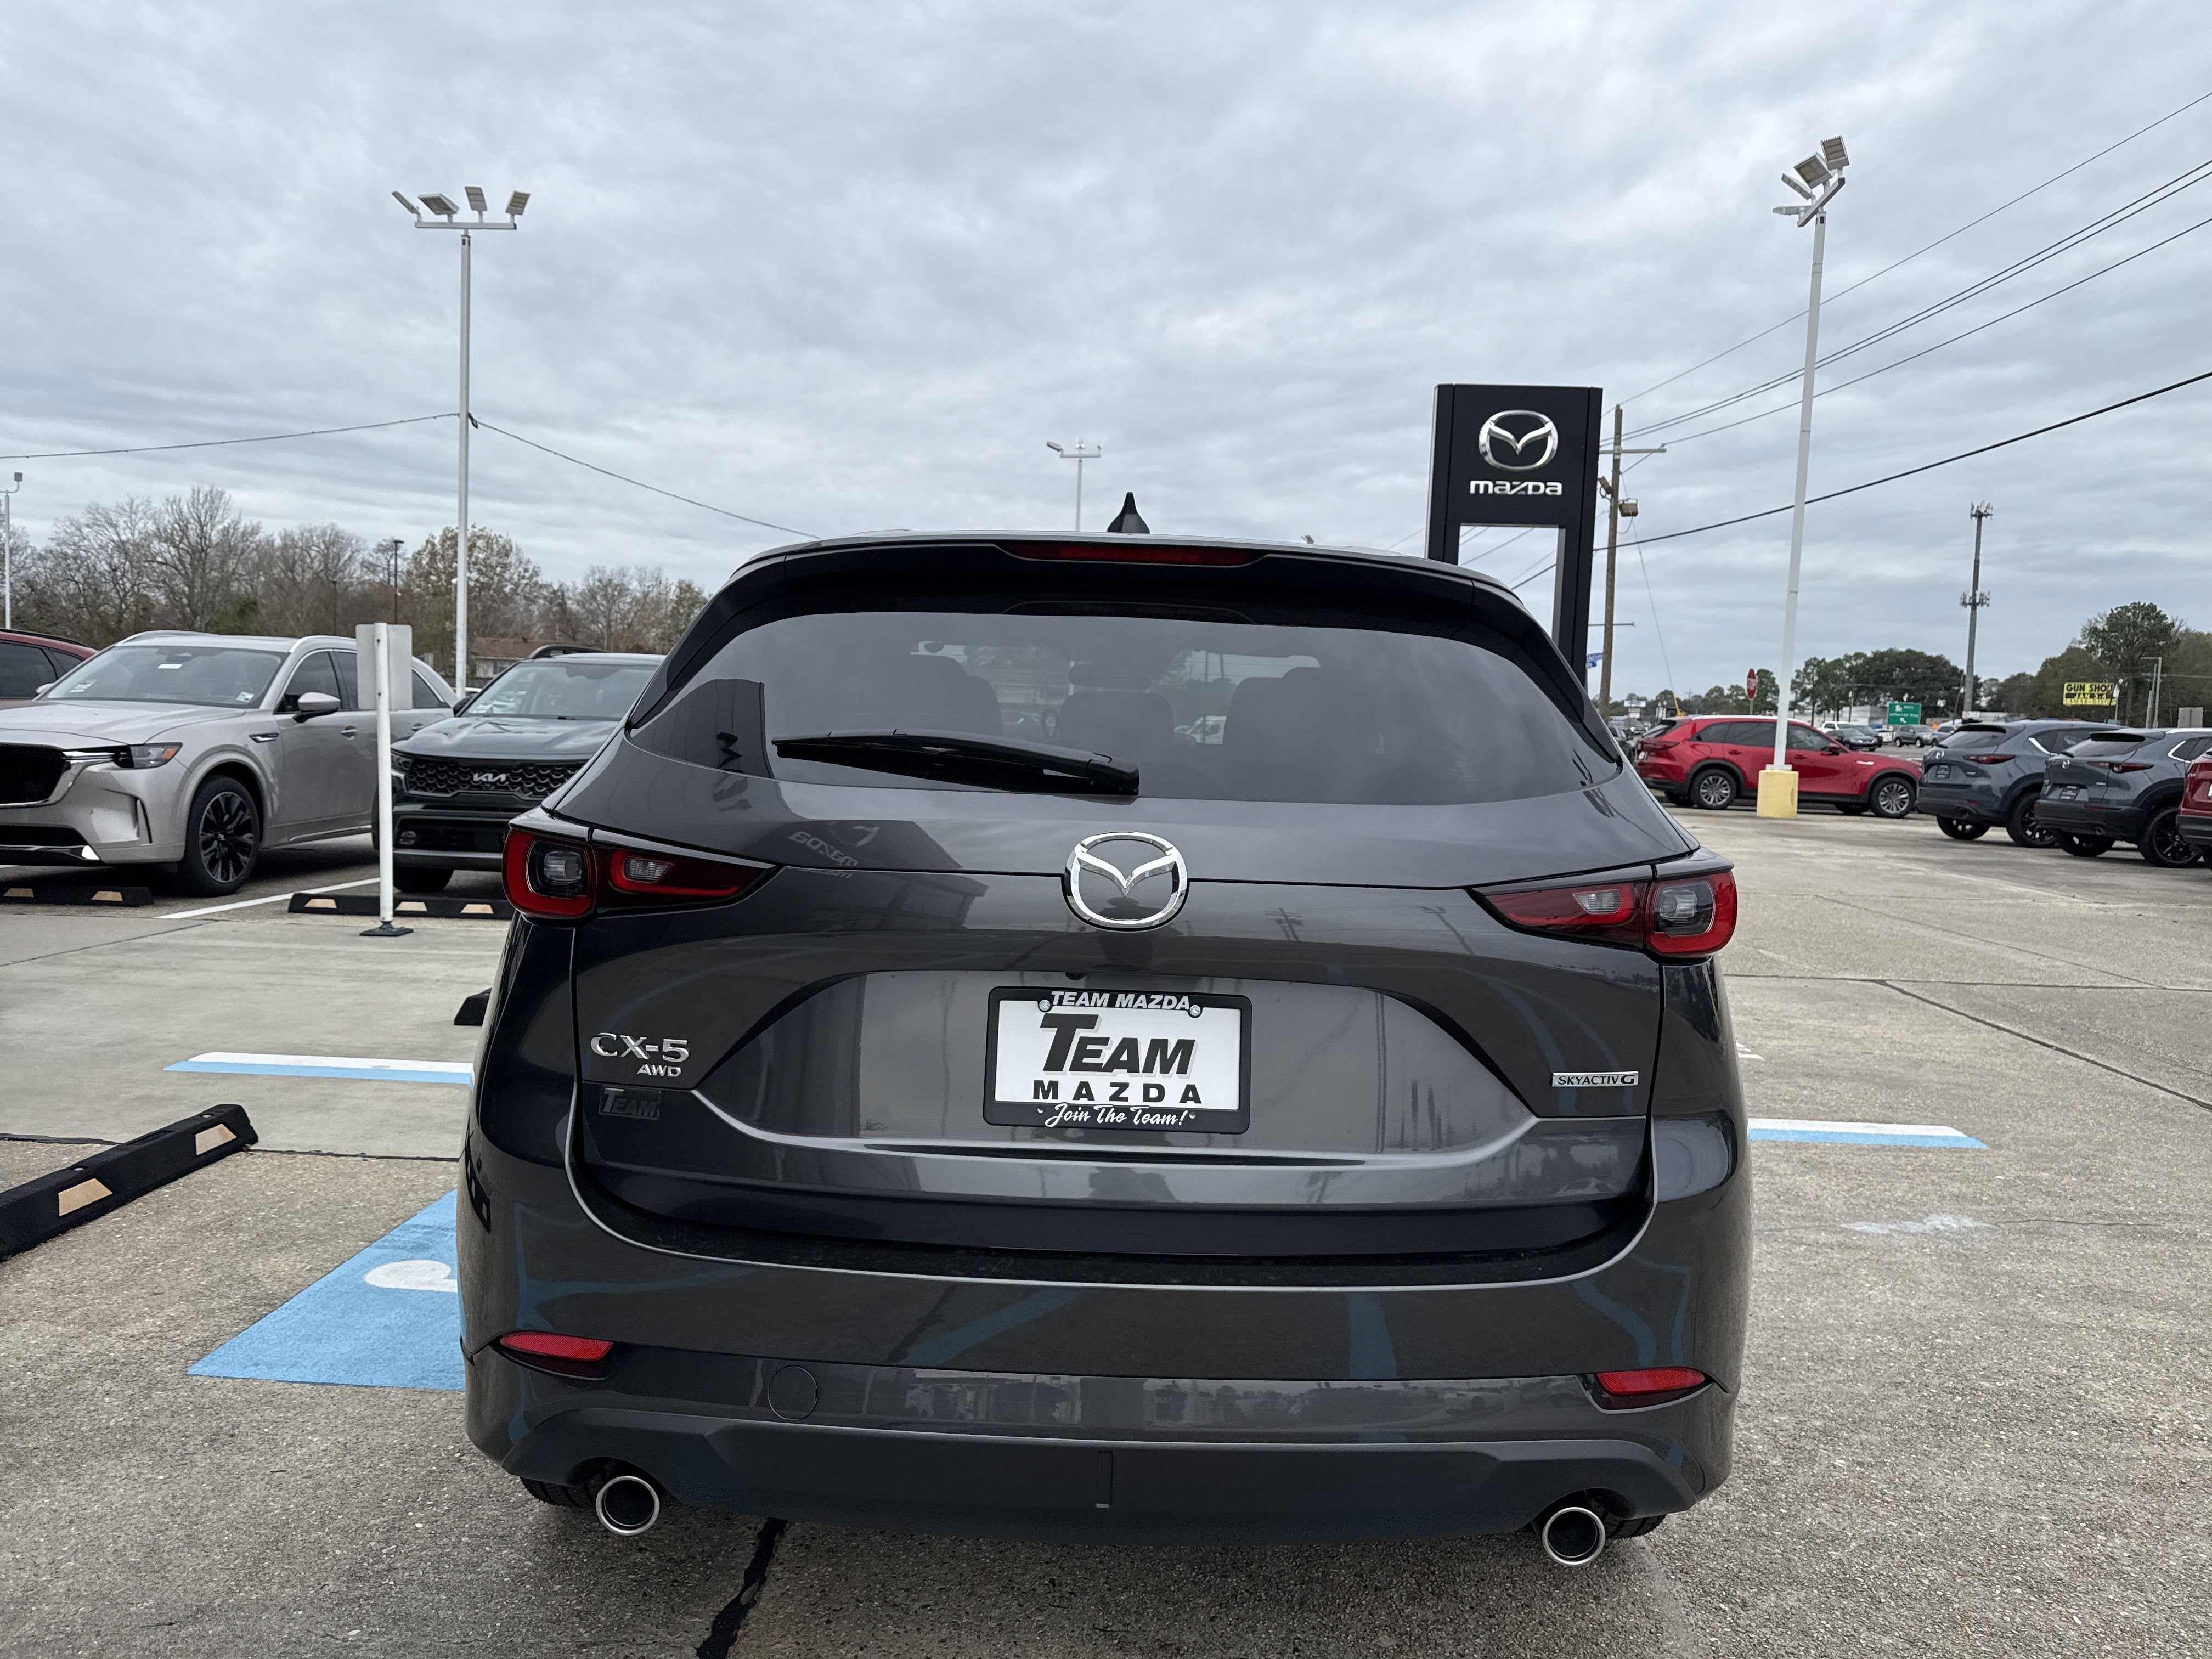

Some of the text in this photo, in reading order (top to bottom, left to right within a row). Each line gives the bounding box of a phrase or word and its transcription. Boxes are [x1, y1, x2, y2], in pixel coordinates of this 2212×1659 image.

[1470, 480, 1562, 495] mazda
[1051, 991, 1190, 1011] TEAM MAZDA
[591, 1032, 690, 1063] CX-5
[1040, 1013, 1198, 1078] TEAM
[637, 1064, 682, 1077] AWD
[1032, 1080, 1202, 1104] MAZDA
[1045, 1103, 1188, 1127] Join The Team!
